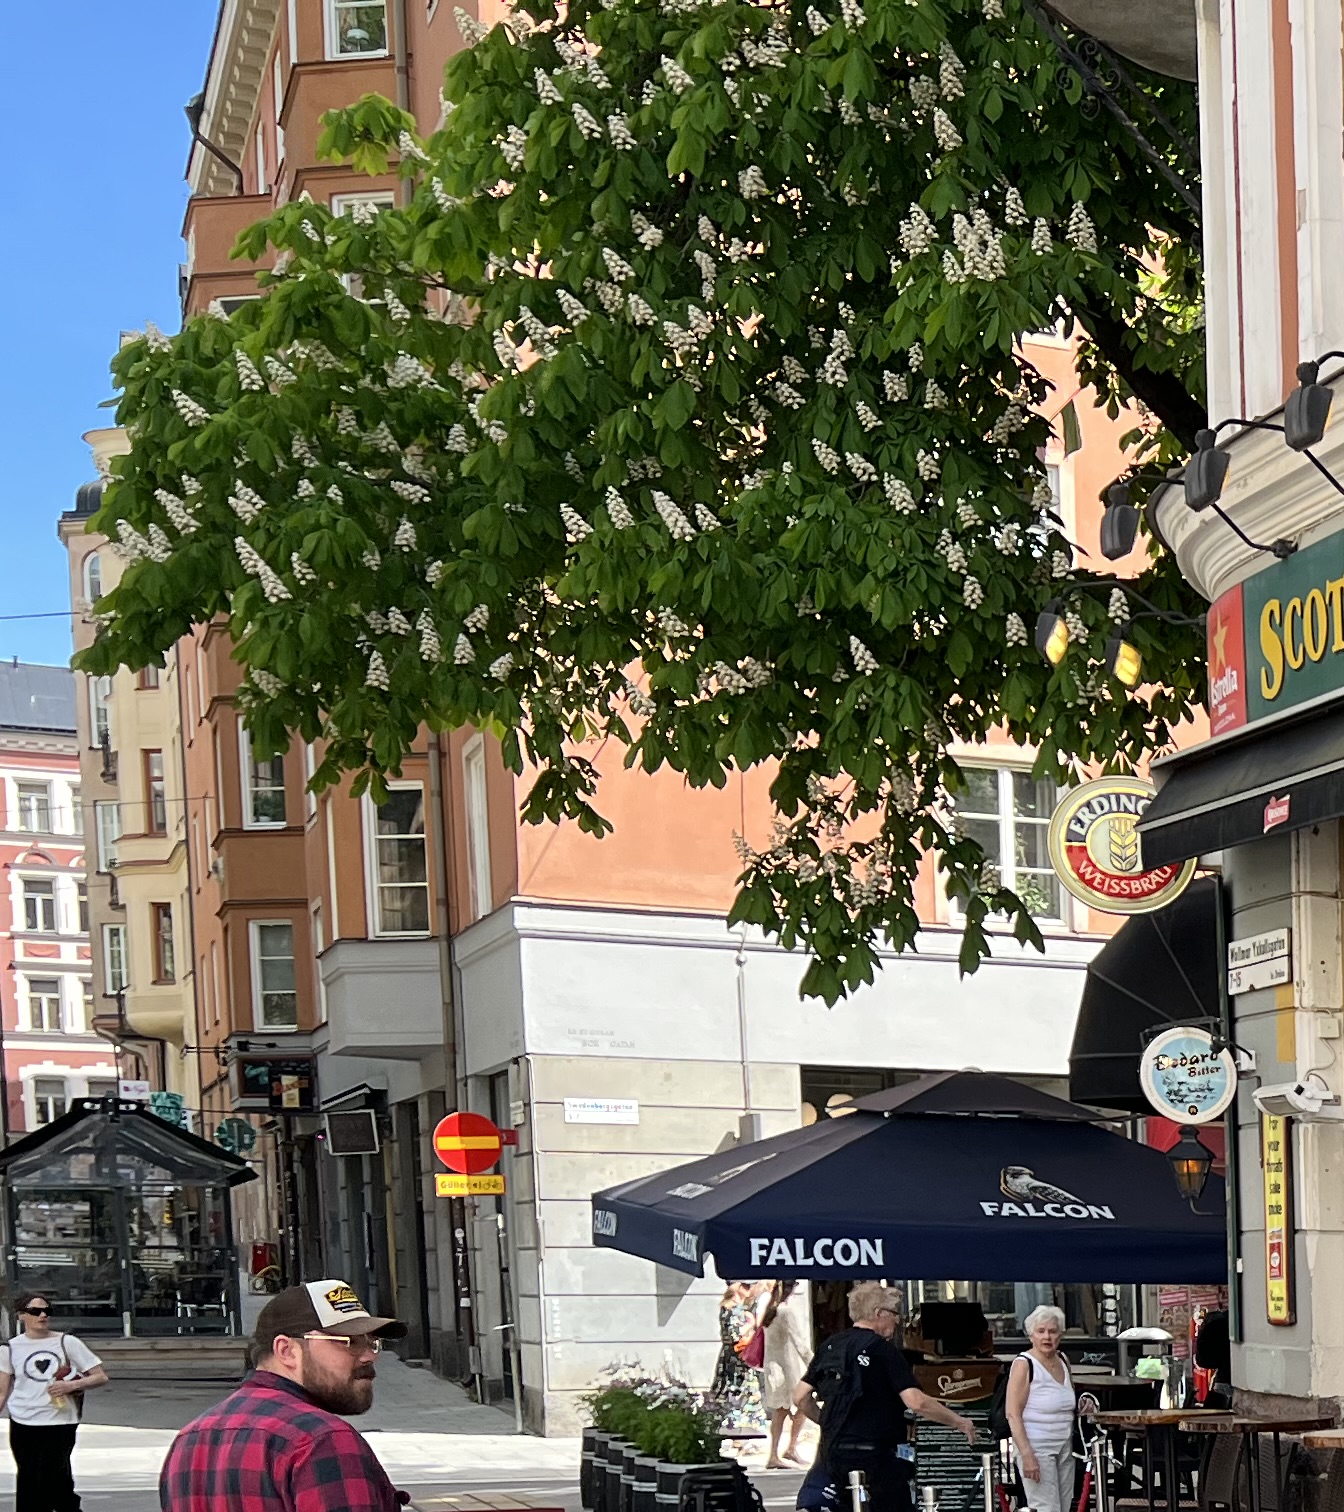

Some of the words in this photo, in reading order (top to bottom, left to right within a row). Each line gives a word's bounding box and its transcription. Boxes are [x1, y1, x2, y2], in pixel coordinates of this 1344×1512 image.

[1078, 860, 1173, 895] WEISSBRÄU
[1187, 1066, 1221, 1077] Bitter
[979, 1201, 1116, 1219] FALCON
[749, 1238, 884, 1266] FALCON
